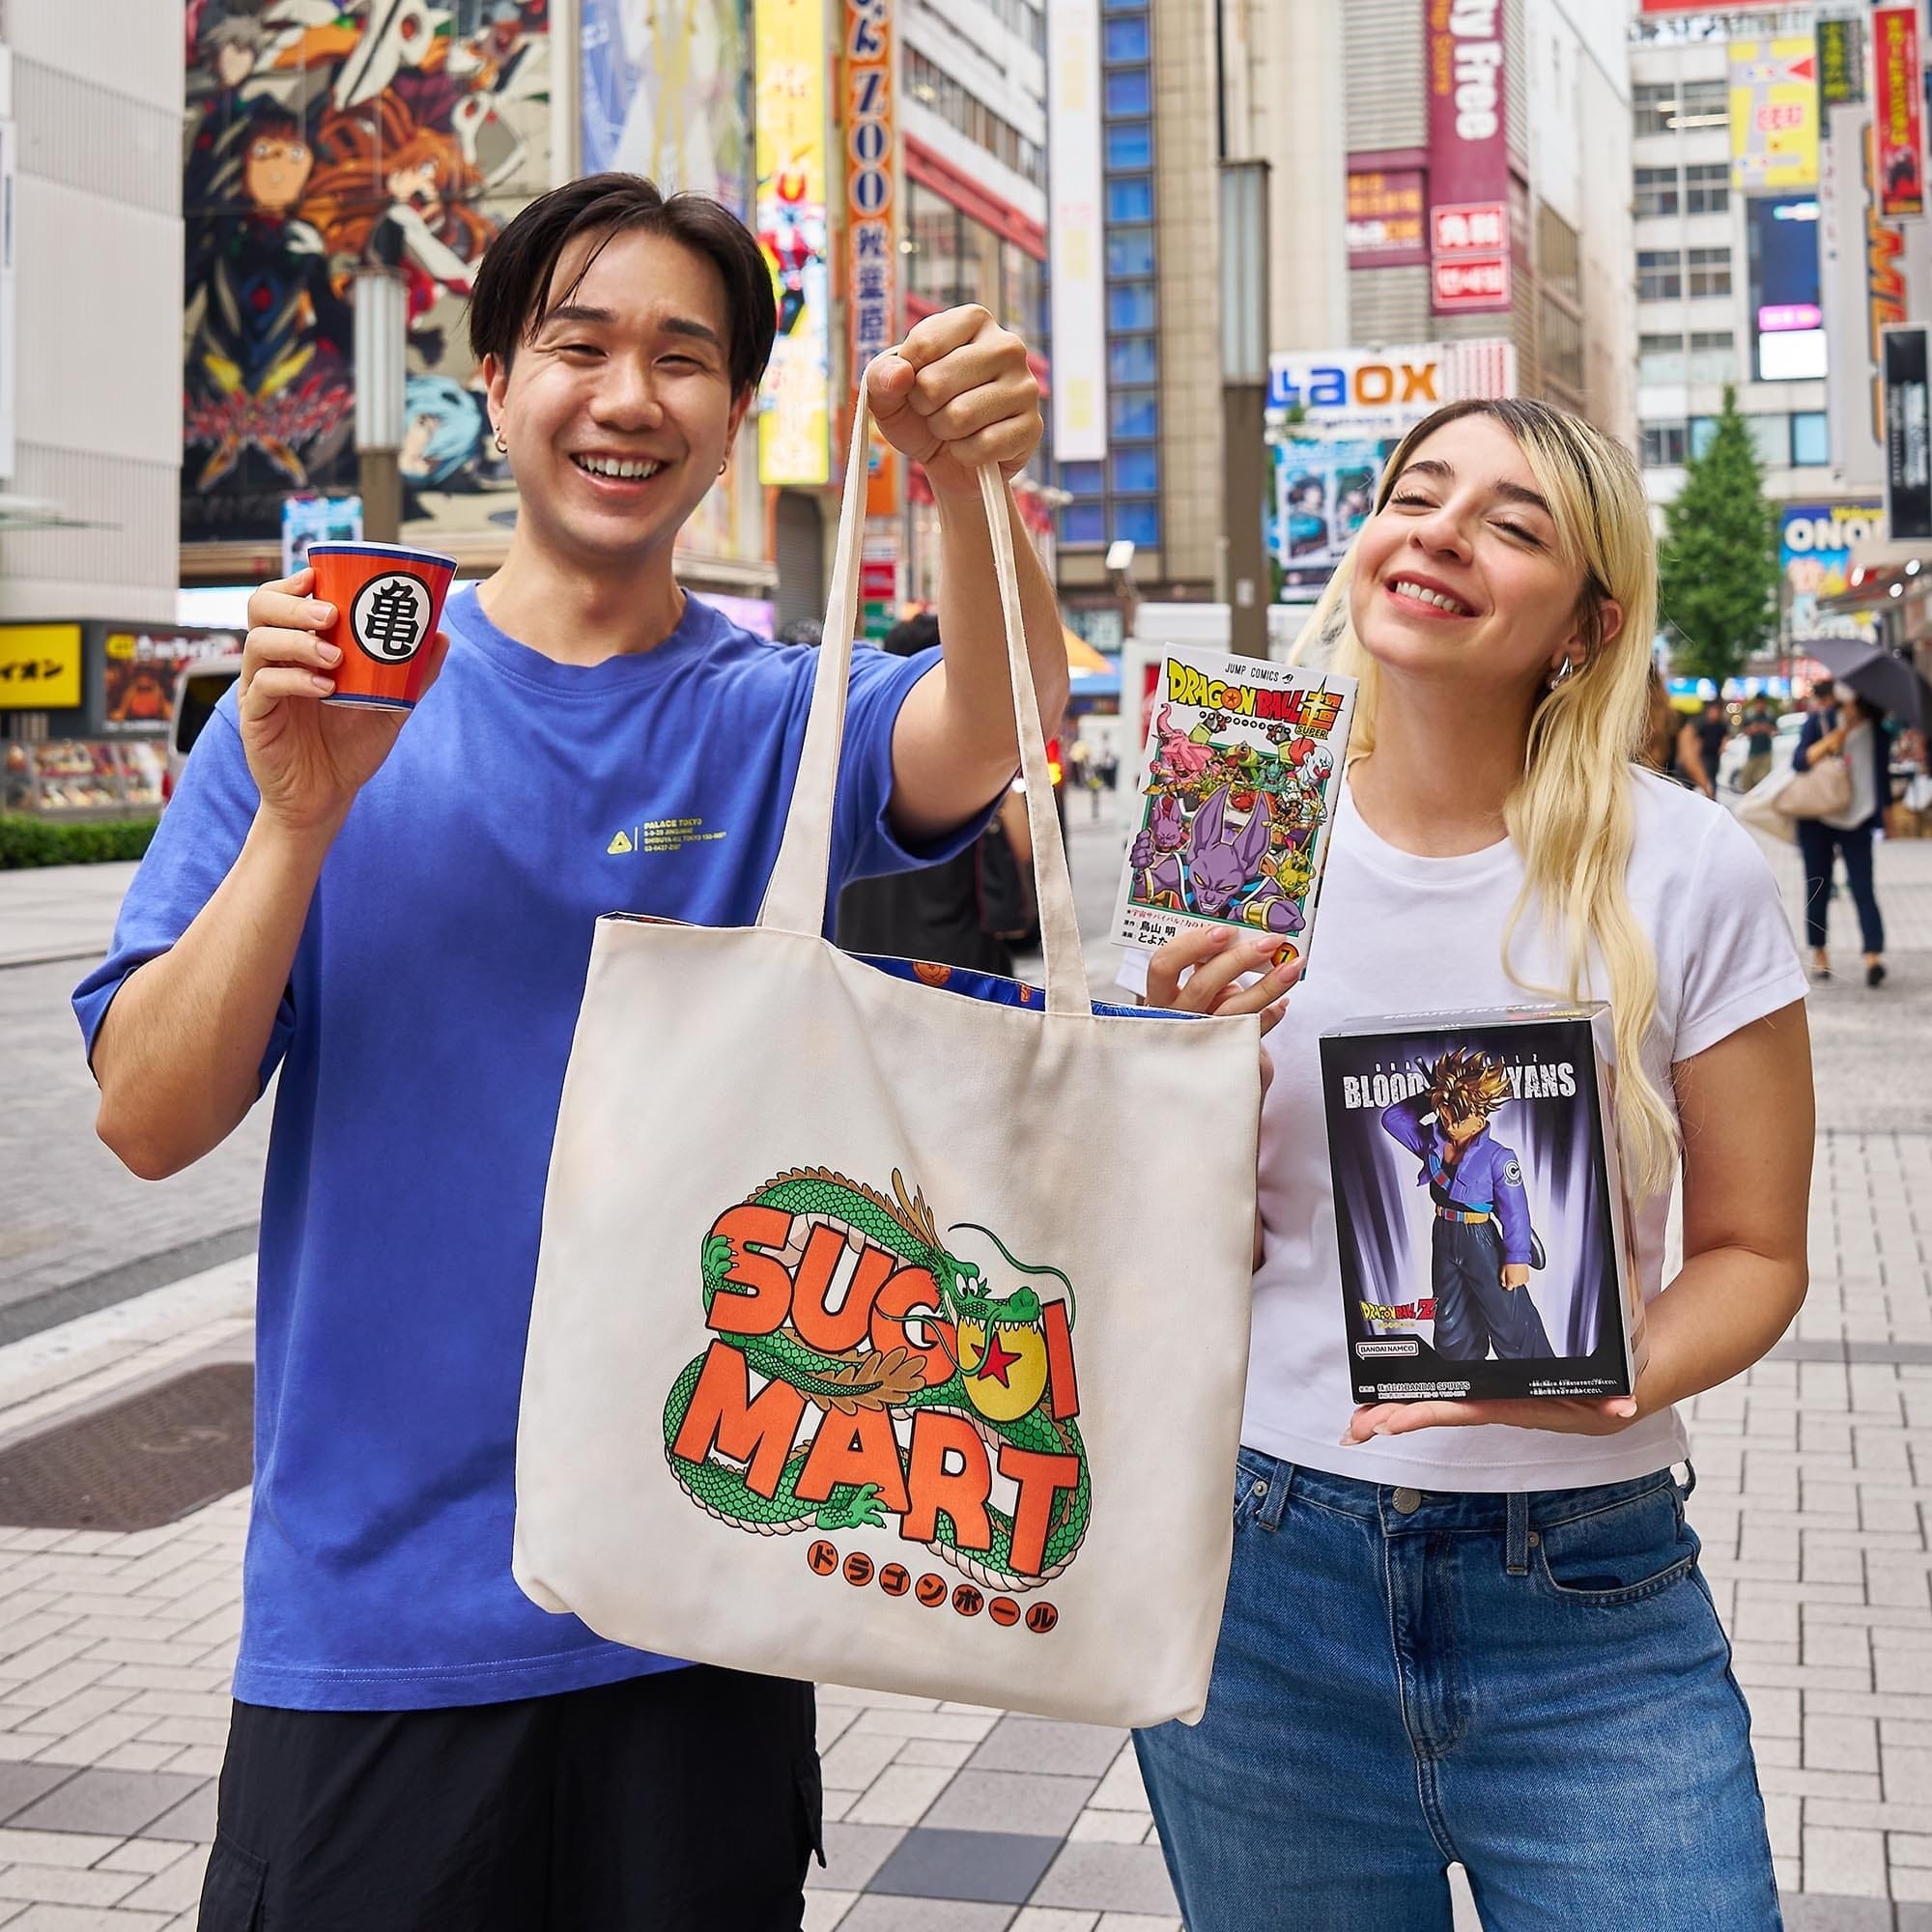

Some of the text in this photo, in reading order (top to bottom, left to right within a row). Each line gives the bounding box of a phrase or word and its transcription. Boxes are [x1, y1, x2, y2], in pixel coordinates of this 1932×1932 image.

[1452, 42, 1503, 141] Free
[364, 579, 420, 657] 亀
[1167, 657, 1256, 716] DRAGON
[1255, 688, 1305, 724] BALL
[1225, 663, 1279, 682] JUMP COMICS
[1294, 724, 1329, 740] SUPER
[643, 817, 702, 830] PALACE TOKYO
[1280, 948, 1291, 964] 7
[1501, 1063, 1577, 1099] YANS
[704, 1202, 1081, 1423] SUGOI
[1360, 1297, 1438, 1321] DRAGON BALL Z
[671, 1337, 1081, 1577] MART
[808, 1541, 1058, 1632] ドラゴンボール
